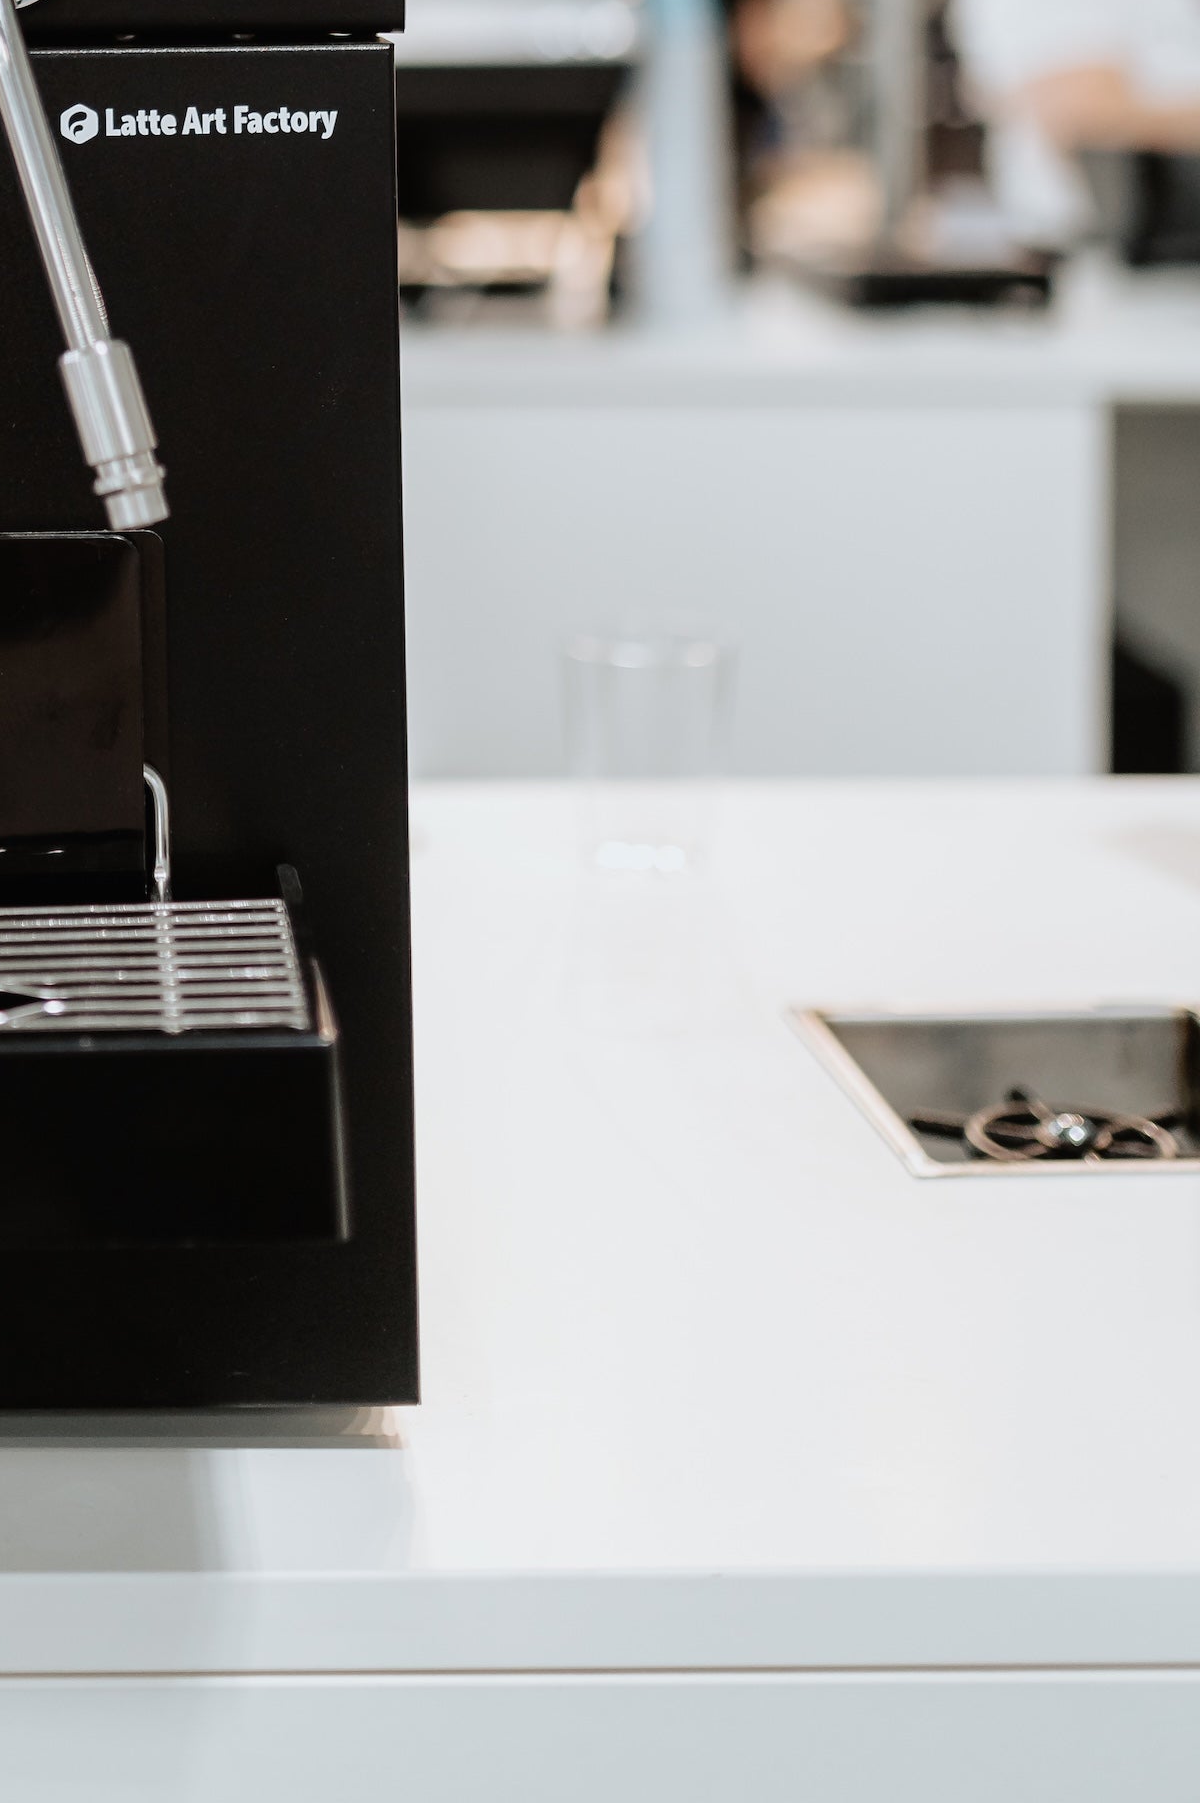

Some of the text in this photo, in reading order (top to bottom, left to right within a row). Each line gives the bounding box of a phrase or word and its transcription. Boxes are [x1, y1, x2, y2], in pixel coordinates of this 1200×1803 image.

[105, 104, 339, 140] Latte Art Factory
